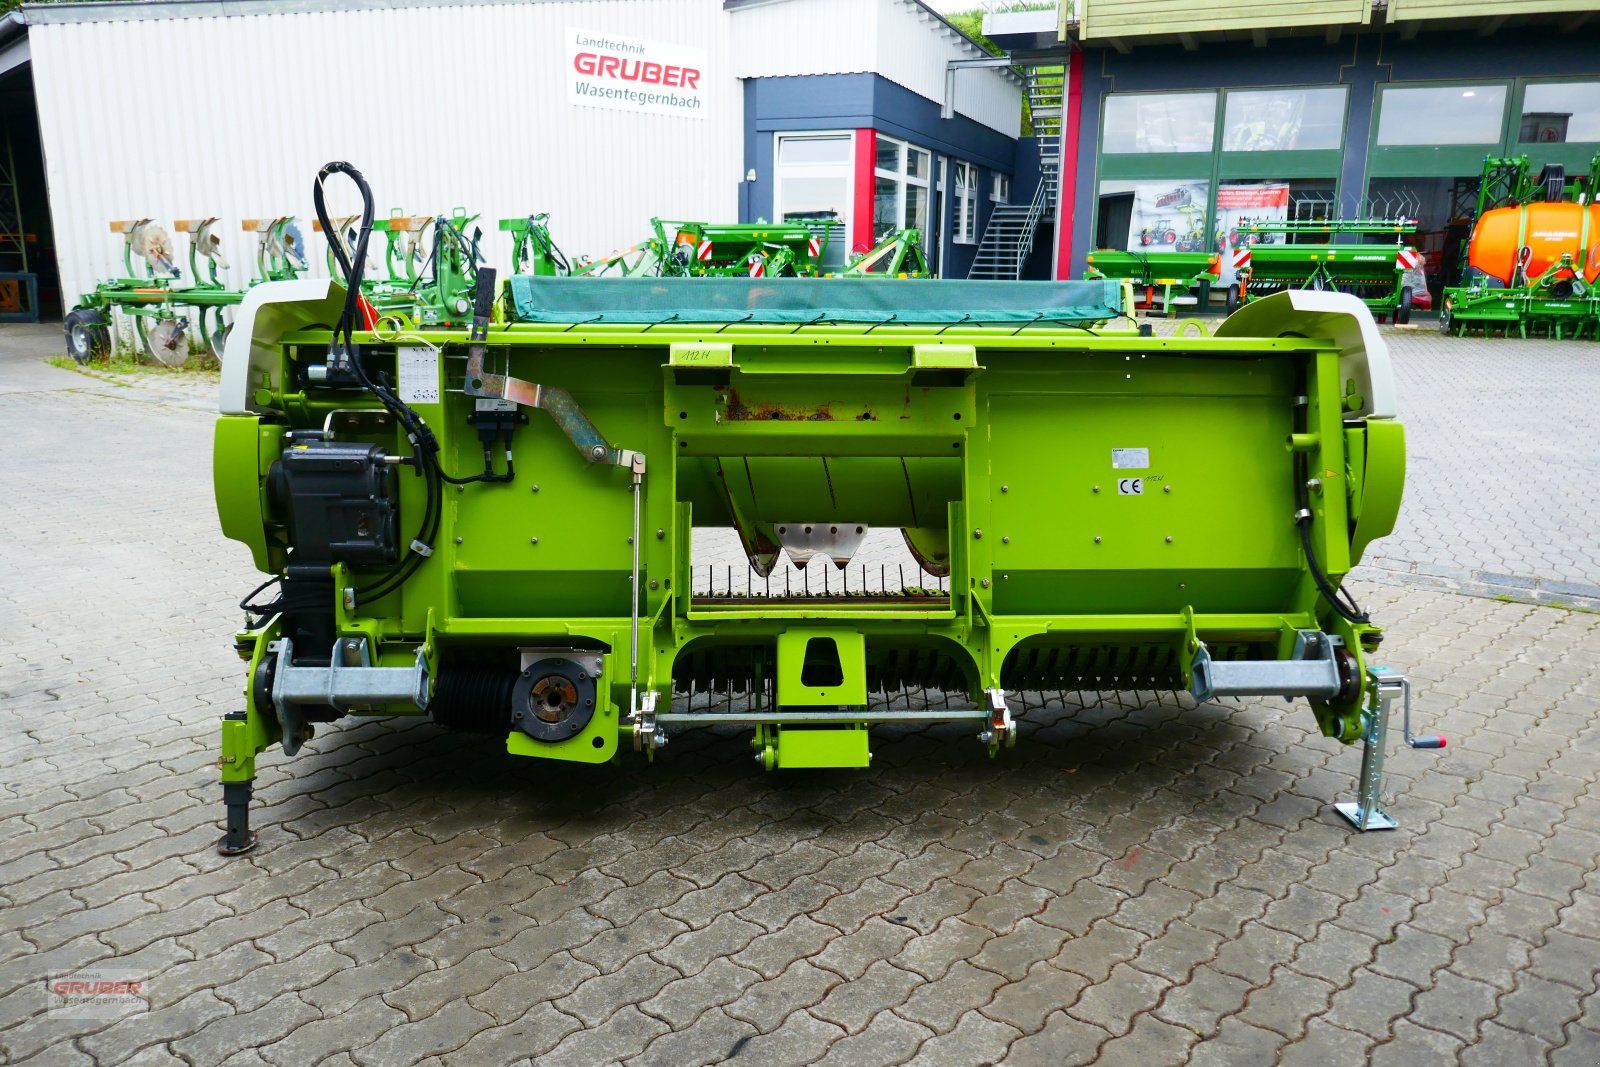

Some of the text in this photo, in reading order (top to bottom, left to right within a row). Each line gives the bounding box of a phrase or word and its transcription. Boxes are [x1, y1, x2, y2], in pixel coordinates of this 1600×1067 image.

[576, 34, 646, 55] Landtechnik
[574, 52, 700, 90] GRUBER
[575, 81, 701, 109] Wasentegernbach
[1120, 479, 1141, 494] CE
